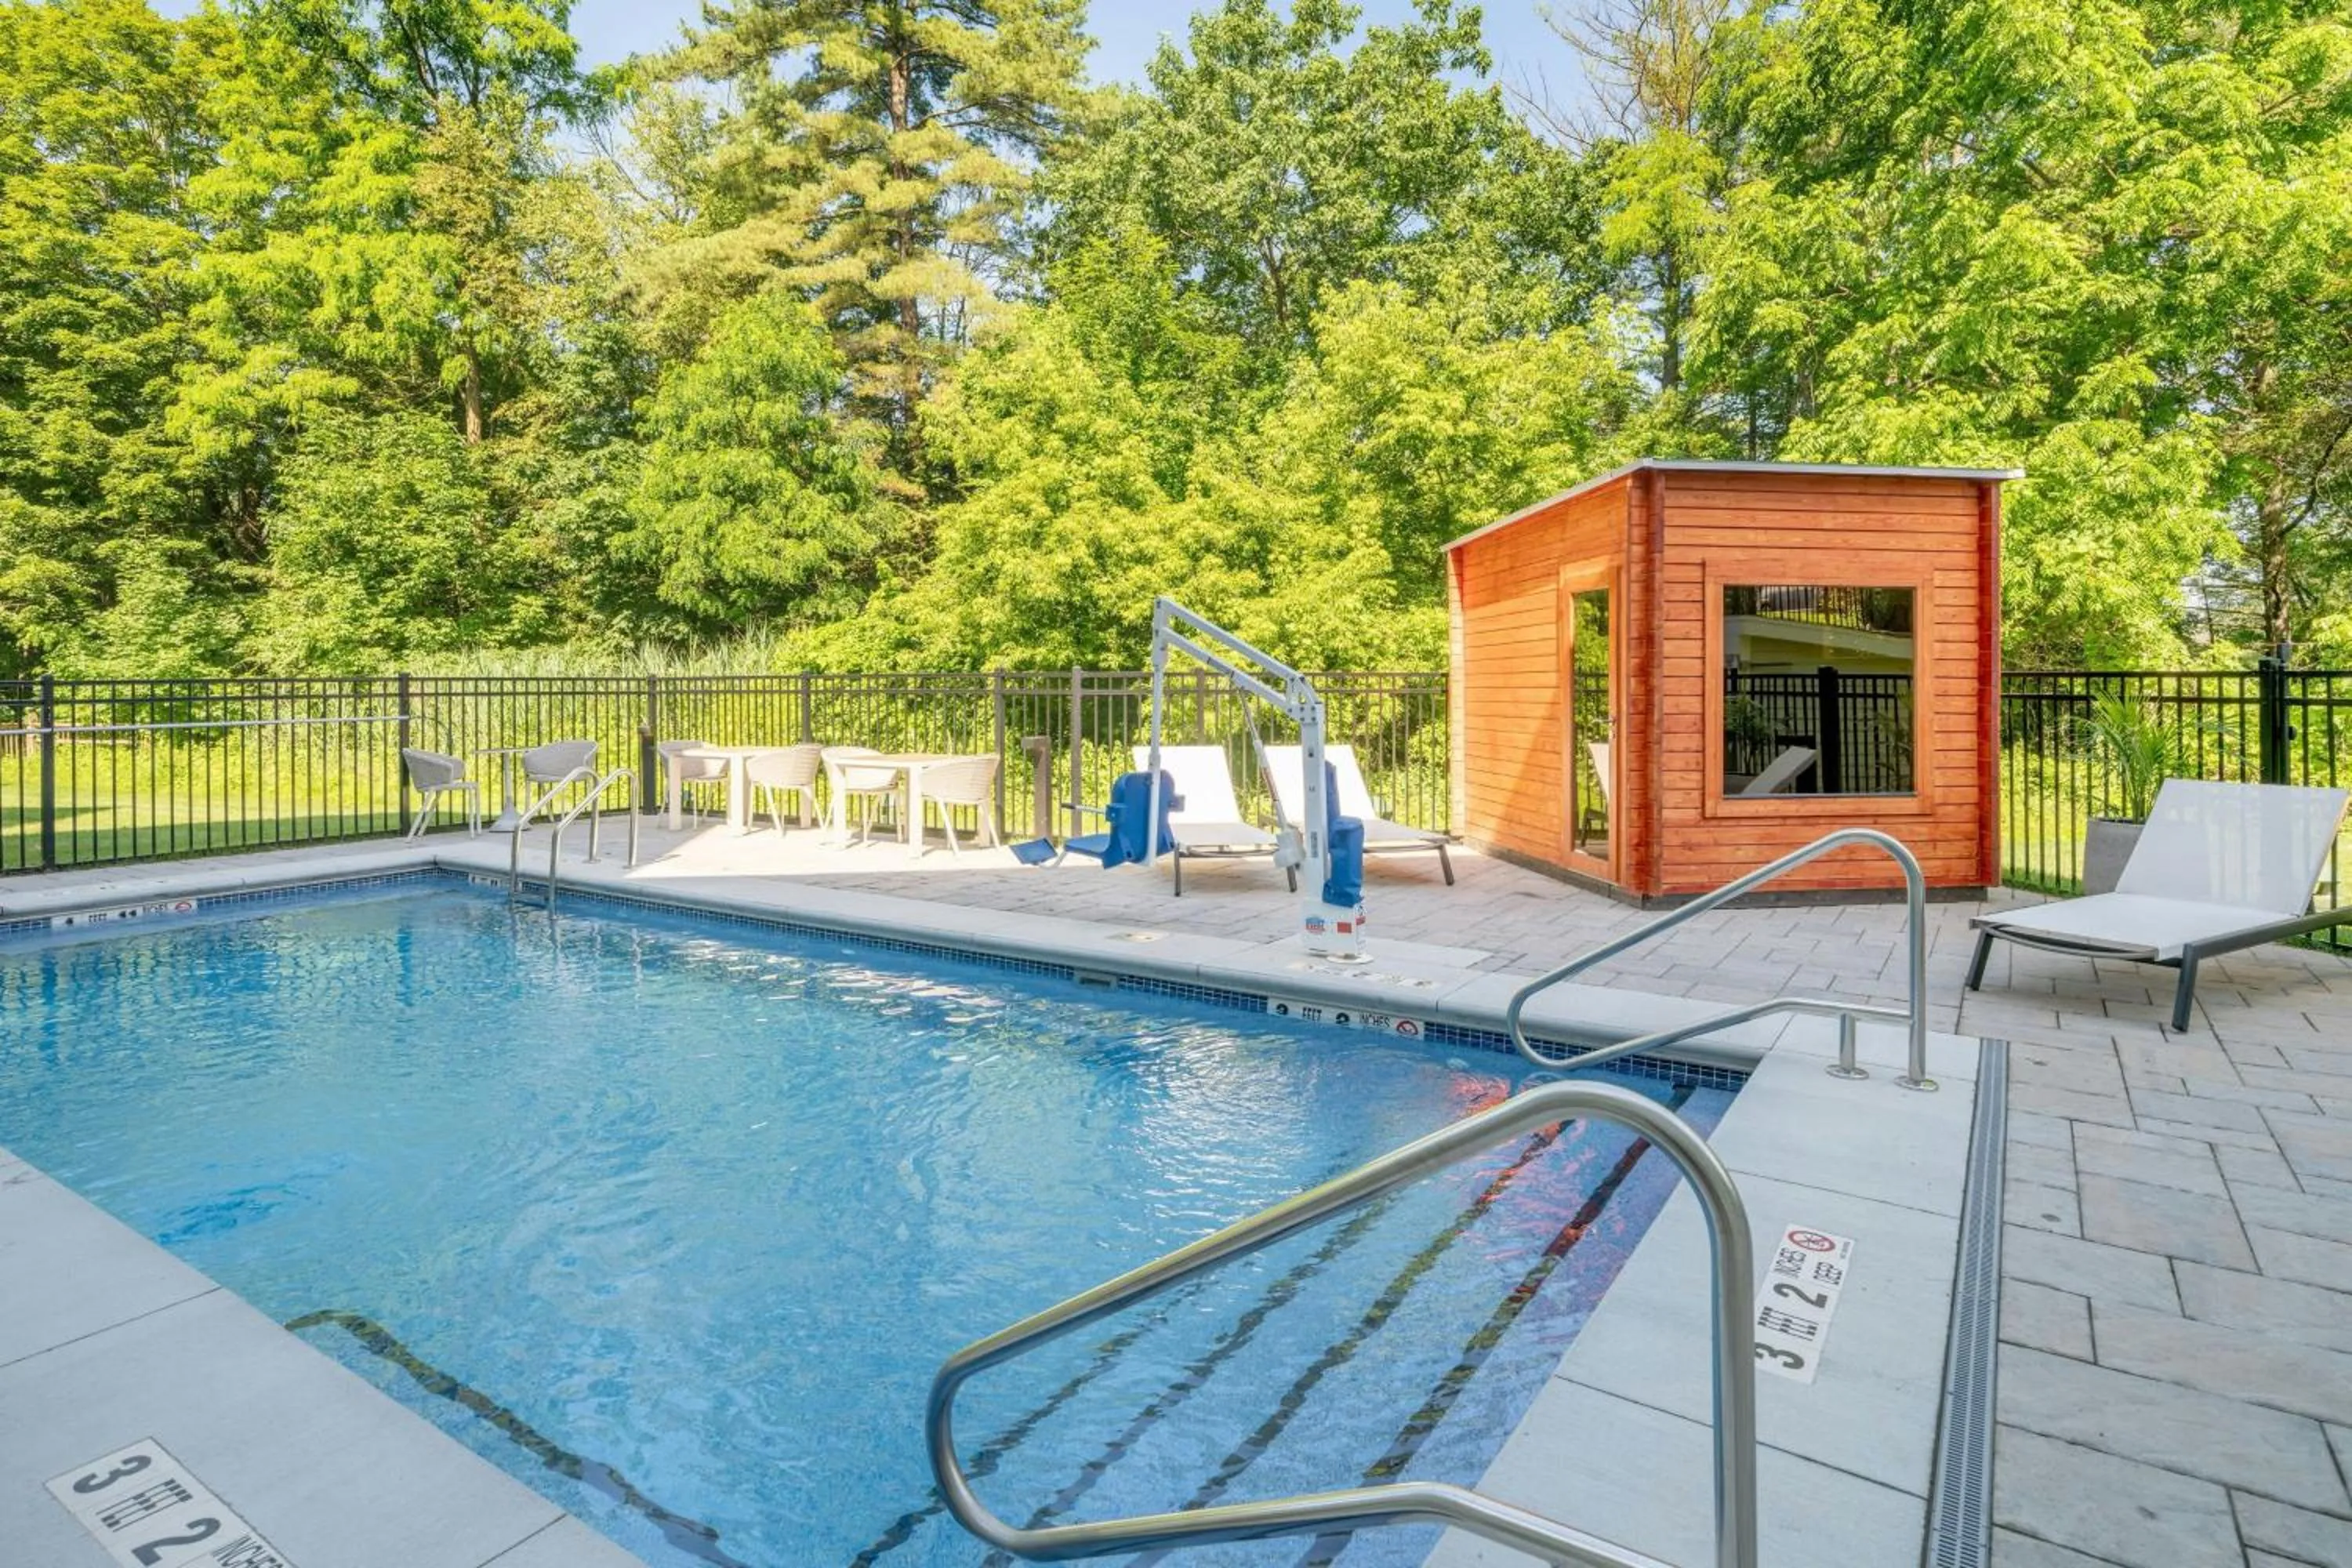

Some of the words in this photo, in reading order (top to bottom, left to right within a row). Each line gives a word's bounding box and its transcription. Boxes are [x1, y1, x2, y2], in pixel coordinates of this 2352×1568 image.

[1773, 1283, 1828, 1308] 2
[1757, 1305, 1819, 1341] FEET
[1754, 1341, 1805, 1370] 3
[73, 1454, 151, 1493] 3
[95, 1476, 193, 1533] FEET
[131, 1517, 221, 1566] 2
